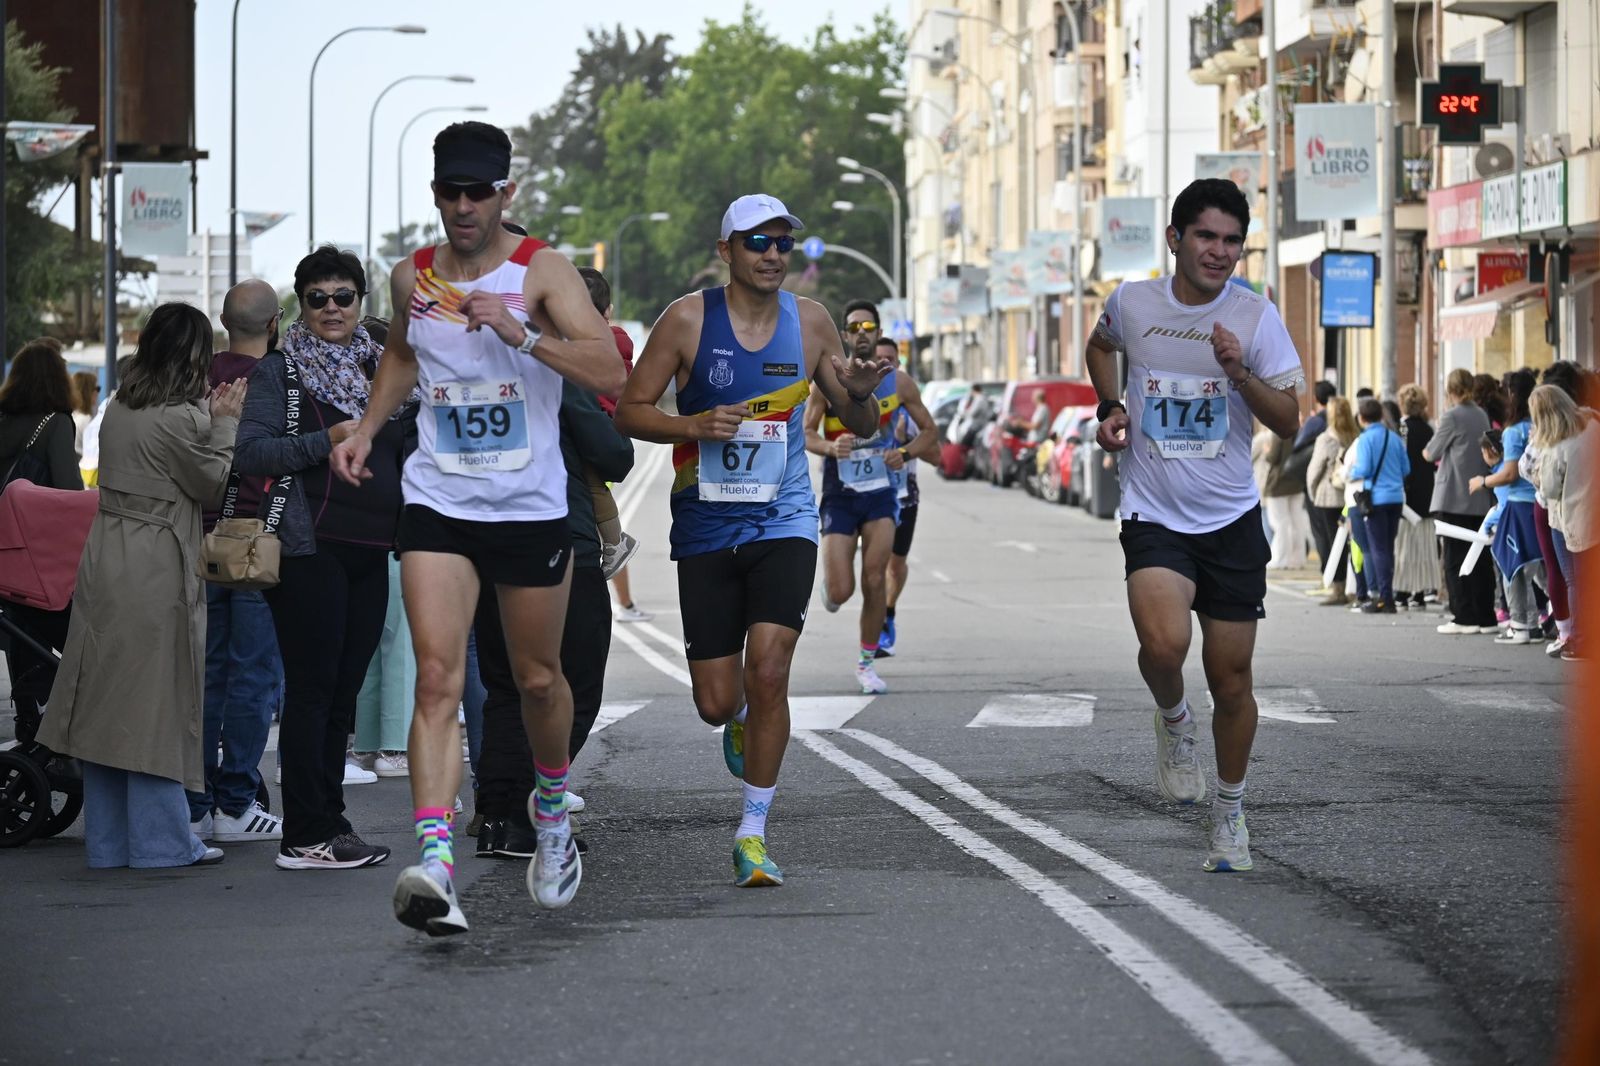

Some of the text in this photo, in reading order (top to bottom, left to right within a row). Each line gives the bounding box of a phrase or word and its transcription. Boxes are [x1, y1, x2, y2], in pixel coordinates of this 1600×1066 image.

[1326, 147, 1369, 159] FERIA
[1311, 160, 1370, 175] LIBRO
[146, 197, 183, 206] FERIA
[133, 207, 183, 219] LIBRO
[712, 348, 734, 356] mobel
[433, 382, 519, 401] 2K 2K
[1147, 379, 1221, 394] 2K 2K
[286, 389, 300, 437] BIMBAY
[1153, 399, 1215, 428] 174
[447, 404, 511, 439] 159
[762, 424, 781, 437] 2K
[1162, 441, 1203, 452] Huelva
[458, 453, 499, 466] Huelva
[721, 442, 761, 472] 67
[852, 459, 873, 476] 78
[720, 484, 758, 495] Huelva
